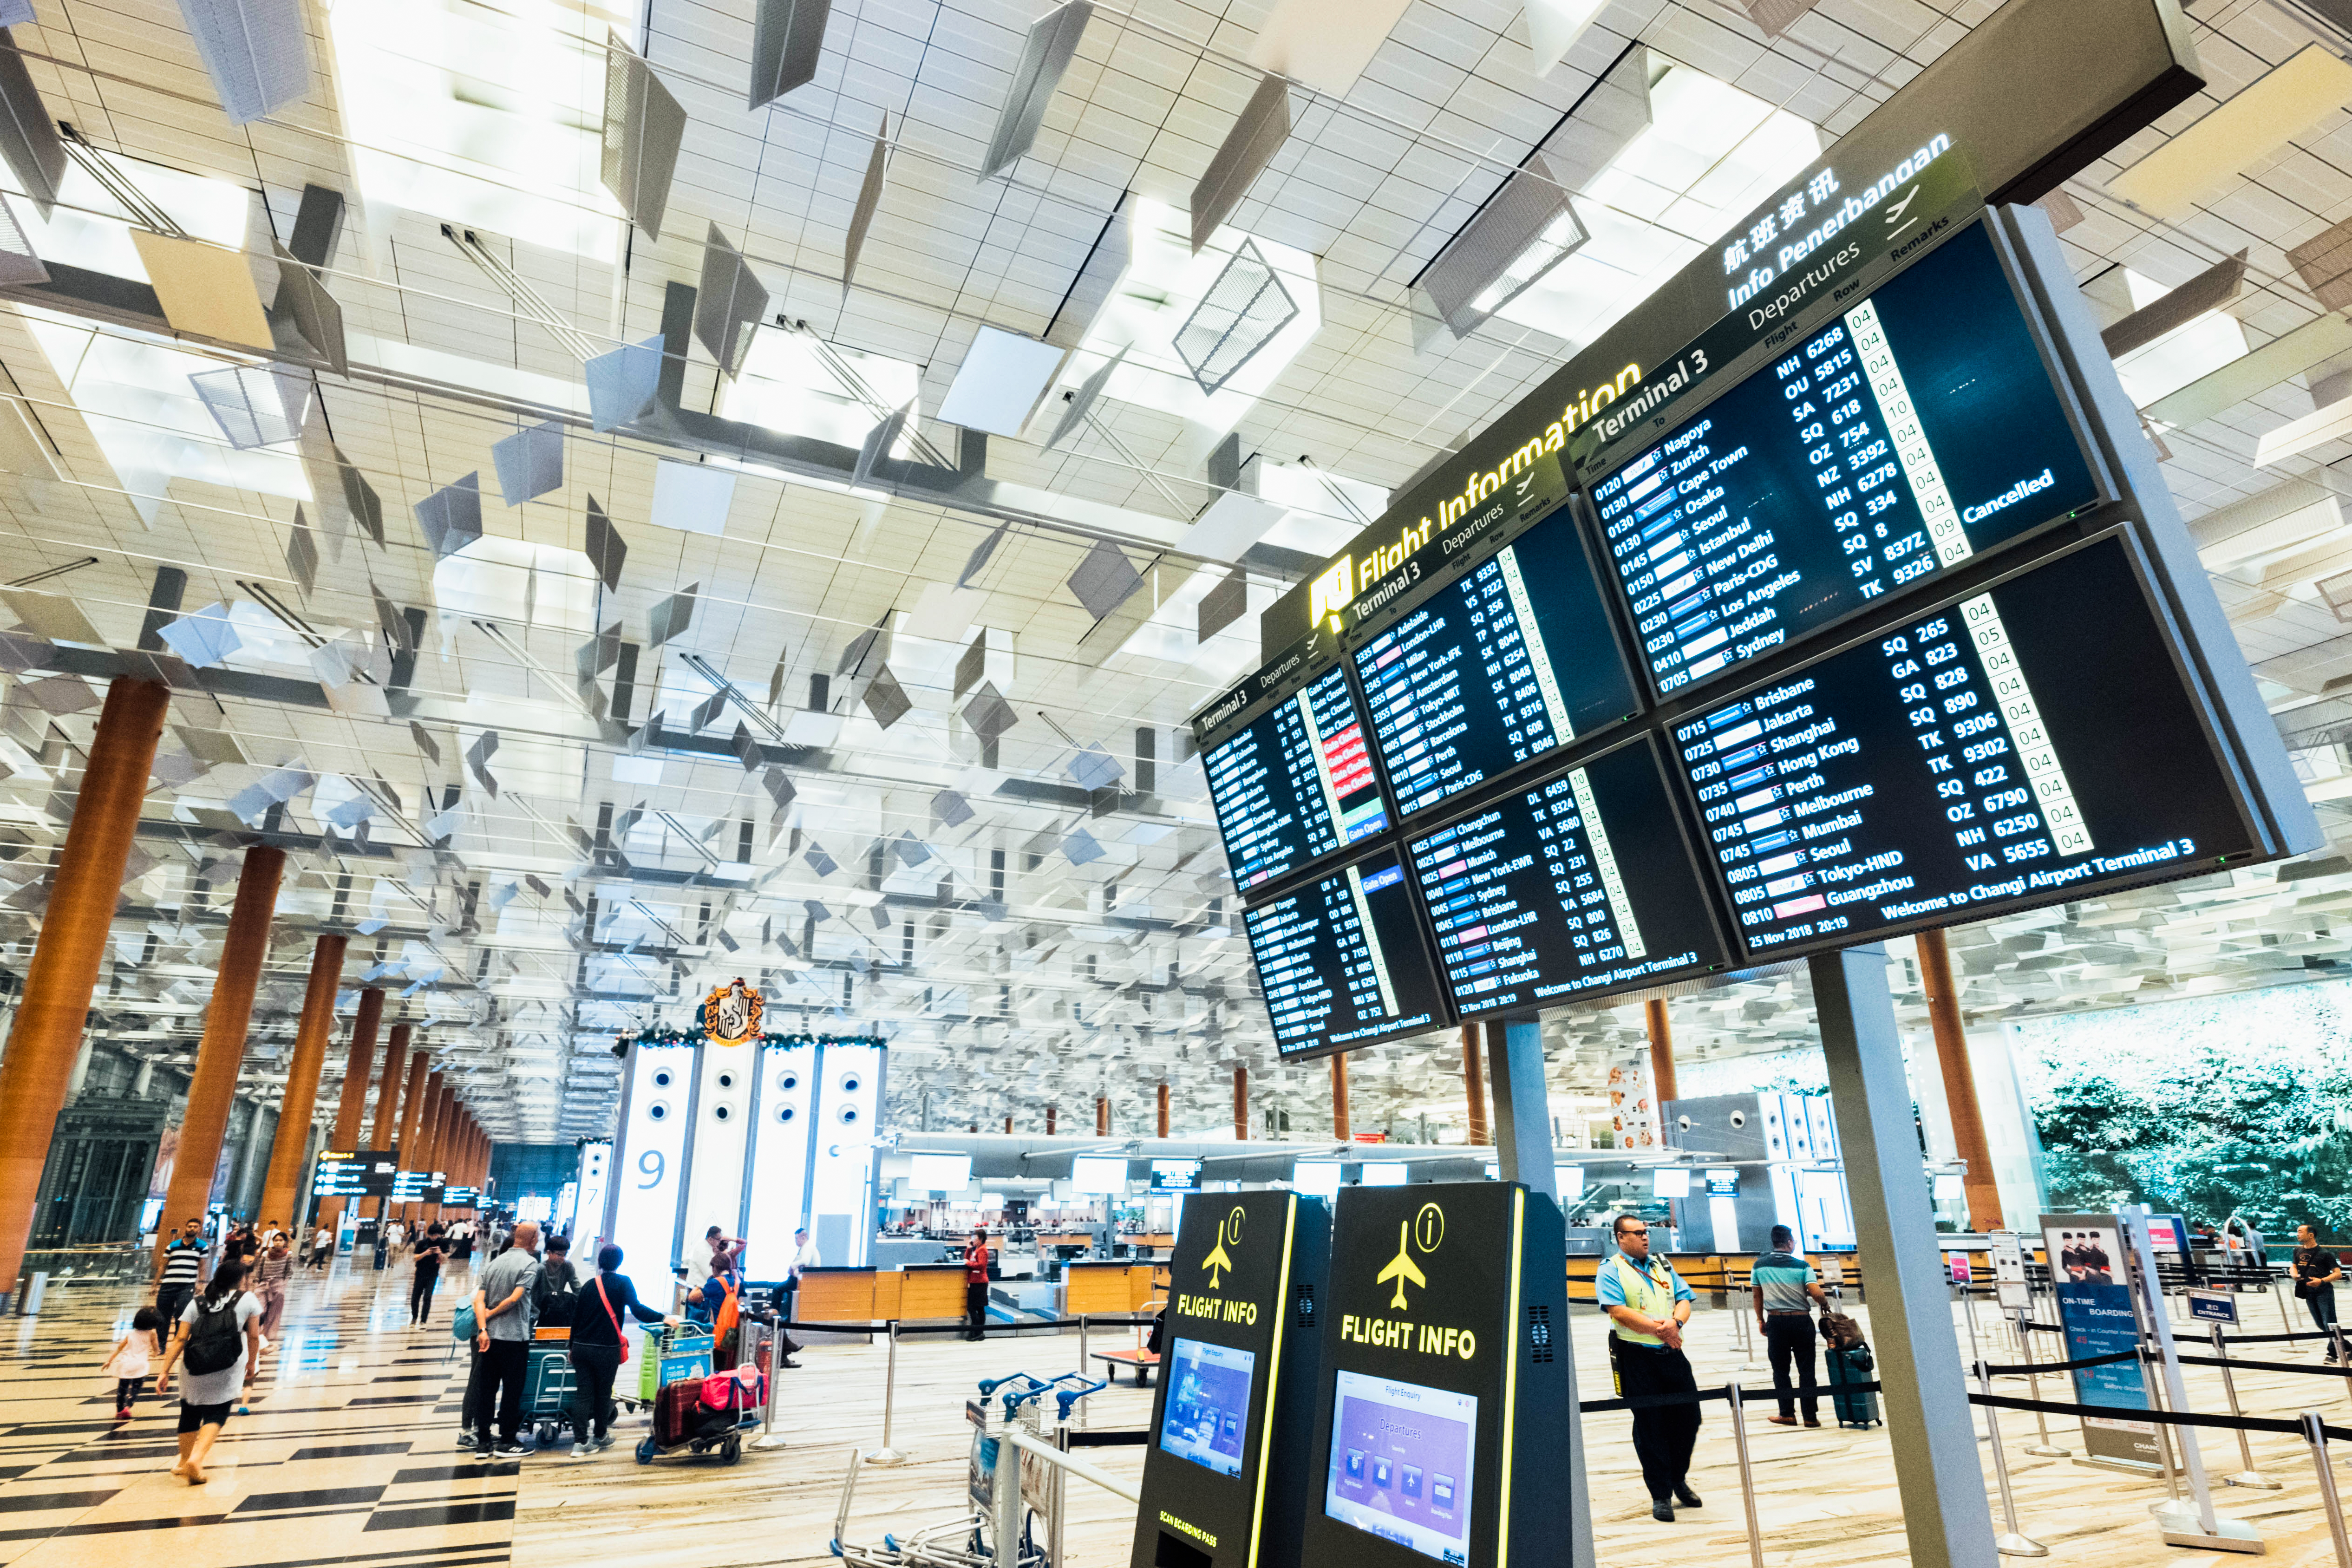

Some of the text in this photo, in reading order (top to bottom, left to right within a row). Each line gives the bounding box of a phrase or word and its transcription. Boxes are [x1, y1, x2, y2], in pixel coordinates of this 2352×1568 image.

[1724, 167, 1840, 274] 航班资讯
[1728, 268, 1773, 311] Info
[1585, 216, 1949, 475] Time To Flight Row Remarks
[1592, 242, 1860, 444] Terminal 3 Departures
[1595, 309, 1871, 501] 0120 Nagoya NH 6268 04
[1607, 354, 1888, 538] 0130 Cape Town SA 7231 04
[1360, 362, 1642, 591] Flight Information
[1620, 400, 1907, 576] 0145 Seoul OZ 754 10
[1353, 503, 1504, 620] Terminal 3 Departures
[1451, 552, 1471, 571] Flight
[1490, 530, 1505, 544] Row
[1519, 497, 1551, 523] Remarks
[1646, 495, 1945, 653] 0230 Los Angeles SQ 8 04
[1653, 468, 2054, 673] 0410 Jeddah SV 837Z 09 Cancelled
[1355, 551, 1512, 664] 2335 Adelaide TK 9332 04
[1202, 654, 1300, 731] Terminal 3 Departures
[1368, 603, 1529, 709] 2355 New York-JFK TP 8416 04
[1378, 639, 1541, 739] 2355 Tokyo-NRT NH 6254 04
[1677, 602, 1990, 741] 0715 Brisbane SQ 265 04
[1205, 752, 1217, 765] 1950
[1232, 728, 1252, 748] Mumbai
[1273, 707, 1283, 719] NH
[1284, 698, 1297, 712] 6419
[1307, 683, 1323, 697] Gate
[1322, 667, 1342, 687] Closed
[1698, 677, 2020, 801] 0735 Hong Kong SQ 890 04
[1249, 923, 1262, 935] 2120
[1279, 911, 1299, 924] Jakarta
[1325, 895, 1332, 906] JT
[1336, 889, 1348, 901] 159
[1362, 879, 1379, 891] Gate
[1378, 872, 1398, 886] Open
[1425, 828, 1603, 901] 0040 New York-EWR SQ 22 04
[1742, 831, 2084, 926] 0810 Guangzhou VA 5655 04
[1880, 838, 2195, 919] Welcome to Changi Airport Terminal 3
[1450, 922, 1635, 980] 0115 Shanghai SQ 826 04
[1748, 916, 1848, 947] 25 Nov 2018 20:19
[588, 1189, 598, 1205] 7
[638, 1150, 665, 1189] 9
[1177, 1294, 1257, 1325] FLIGHT INFO
[1342, 1315, 1476, 1359] FLIGHT INFO
[2089, 1308, 2134, 1317] BOARDING
[2197, 1310, 2230, 1319] ENTRANCE
[1380, 1419, 1421, 1439] Departures
[1385, 1385, 1421, 1402] Flight Enquiry
[1160, 1510, 1217, 1547] SCAN BOARDING PASS
